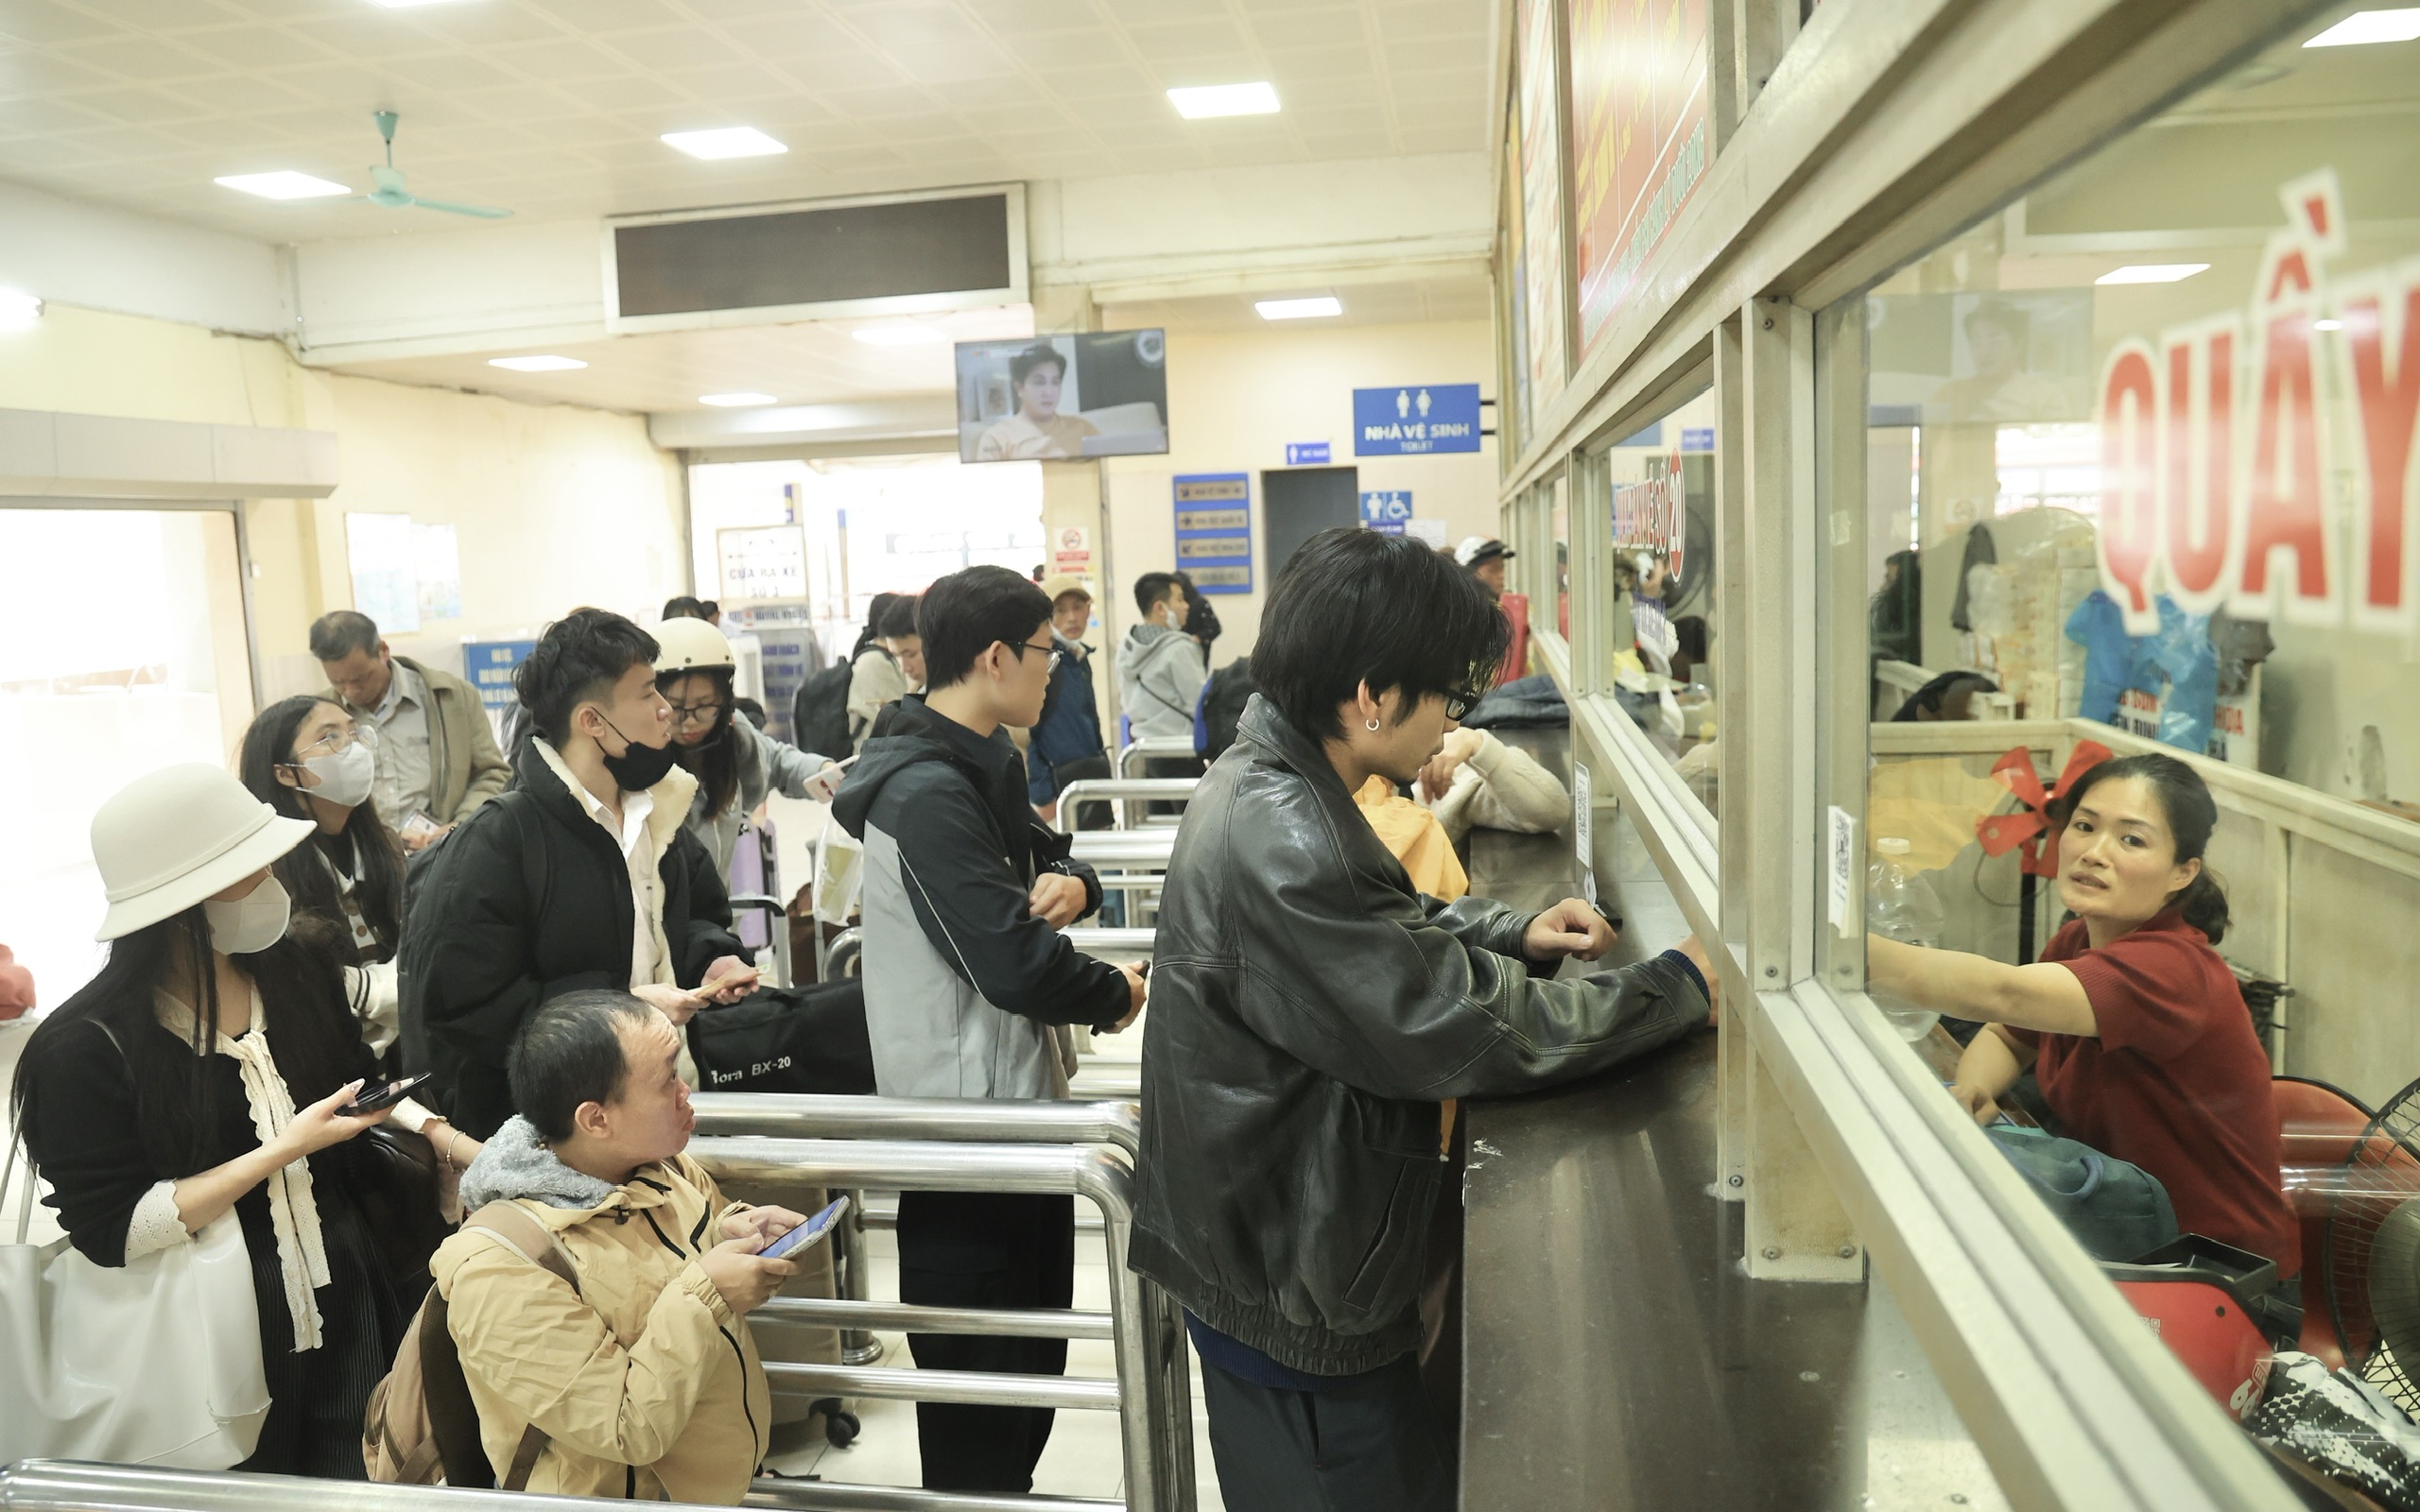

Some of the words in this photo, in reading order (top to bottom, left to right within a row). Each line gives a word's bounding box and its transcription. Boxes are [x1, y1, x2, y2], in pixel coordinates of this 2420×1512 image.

[2098, 170, 2420, 631] QUẦY
[1364, 422, 1402, 441] NHÀ
[1430, 422, 1470, 438] SINH
[1654, 457, 1667, 555] SỐ
[1669, 470, 1684, 553] 20
[752, 1056, 791, 1076] BX-20
